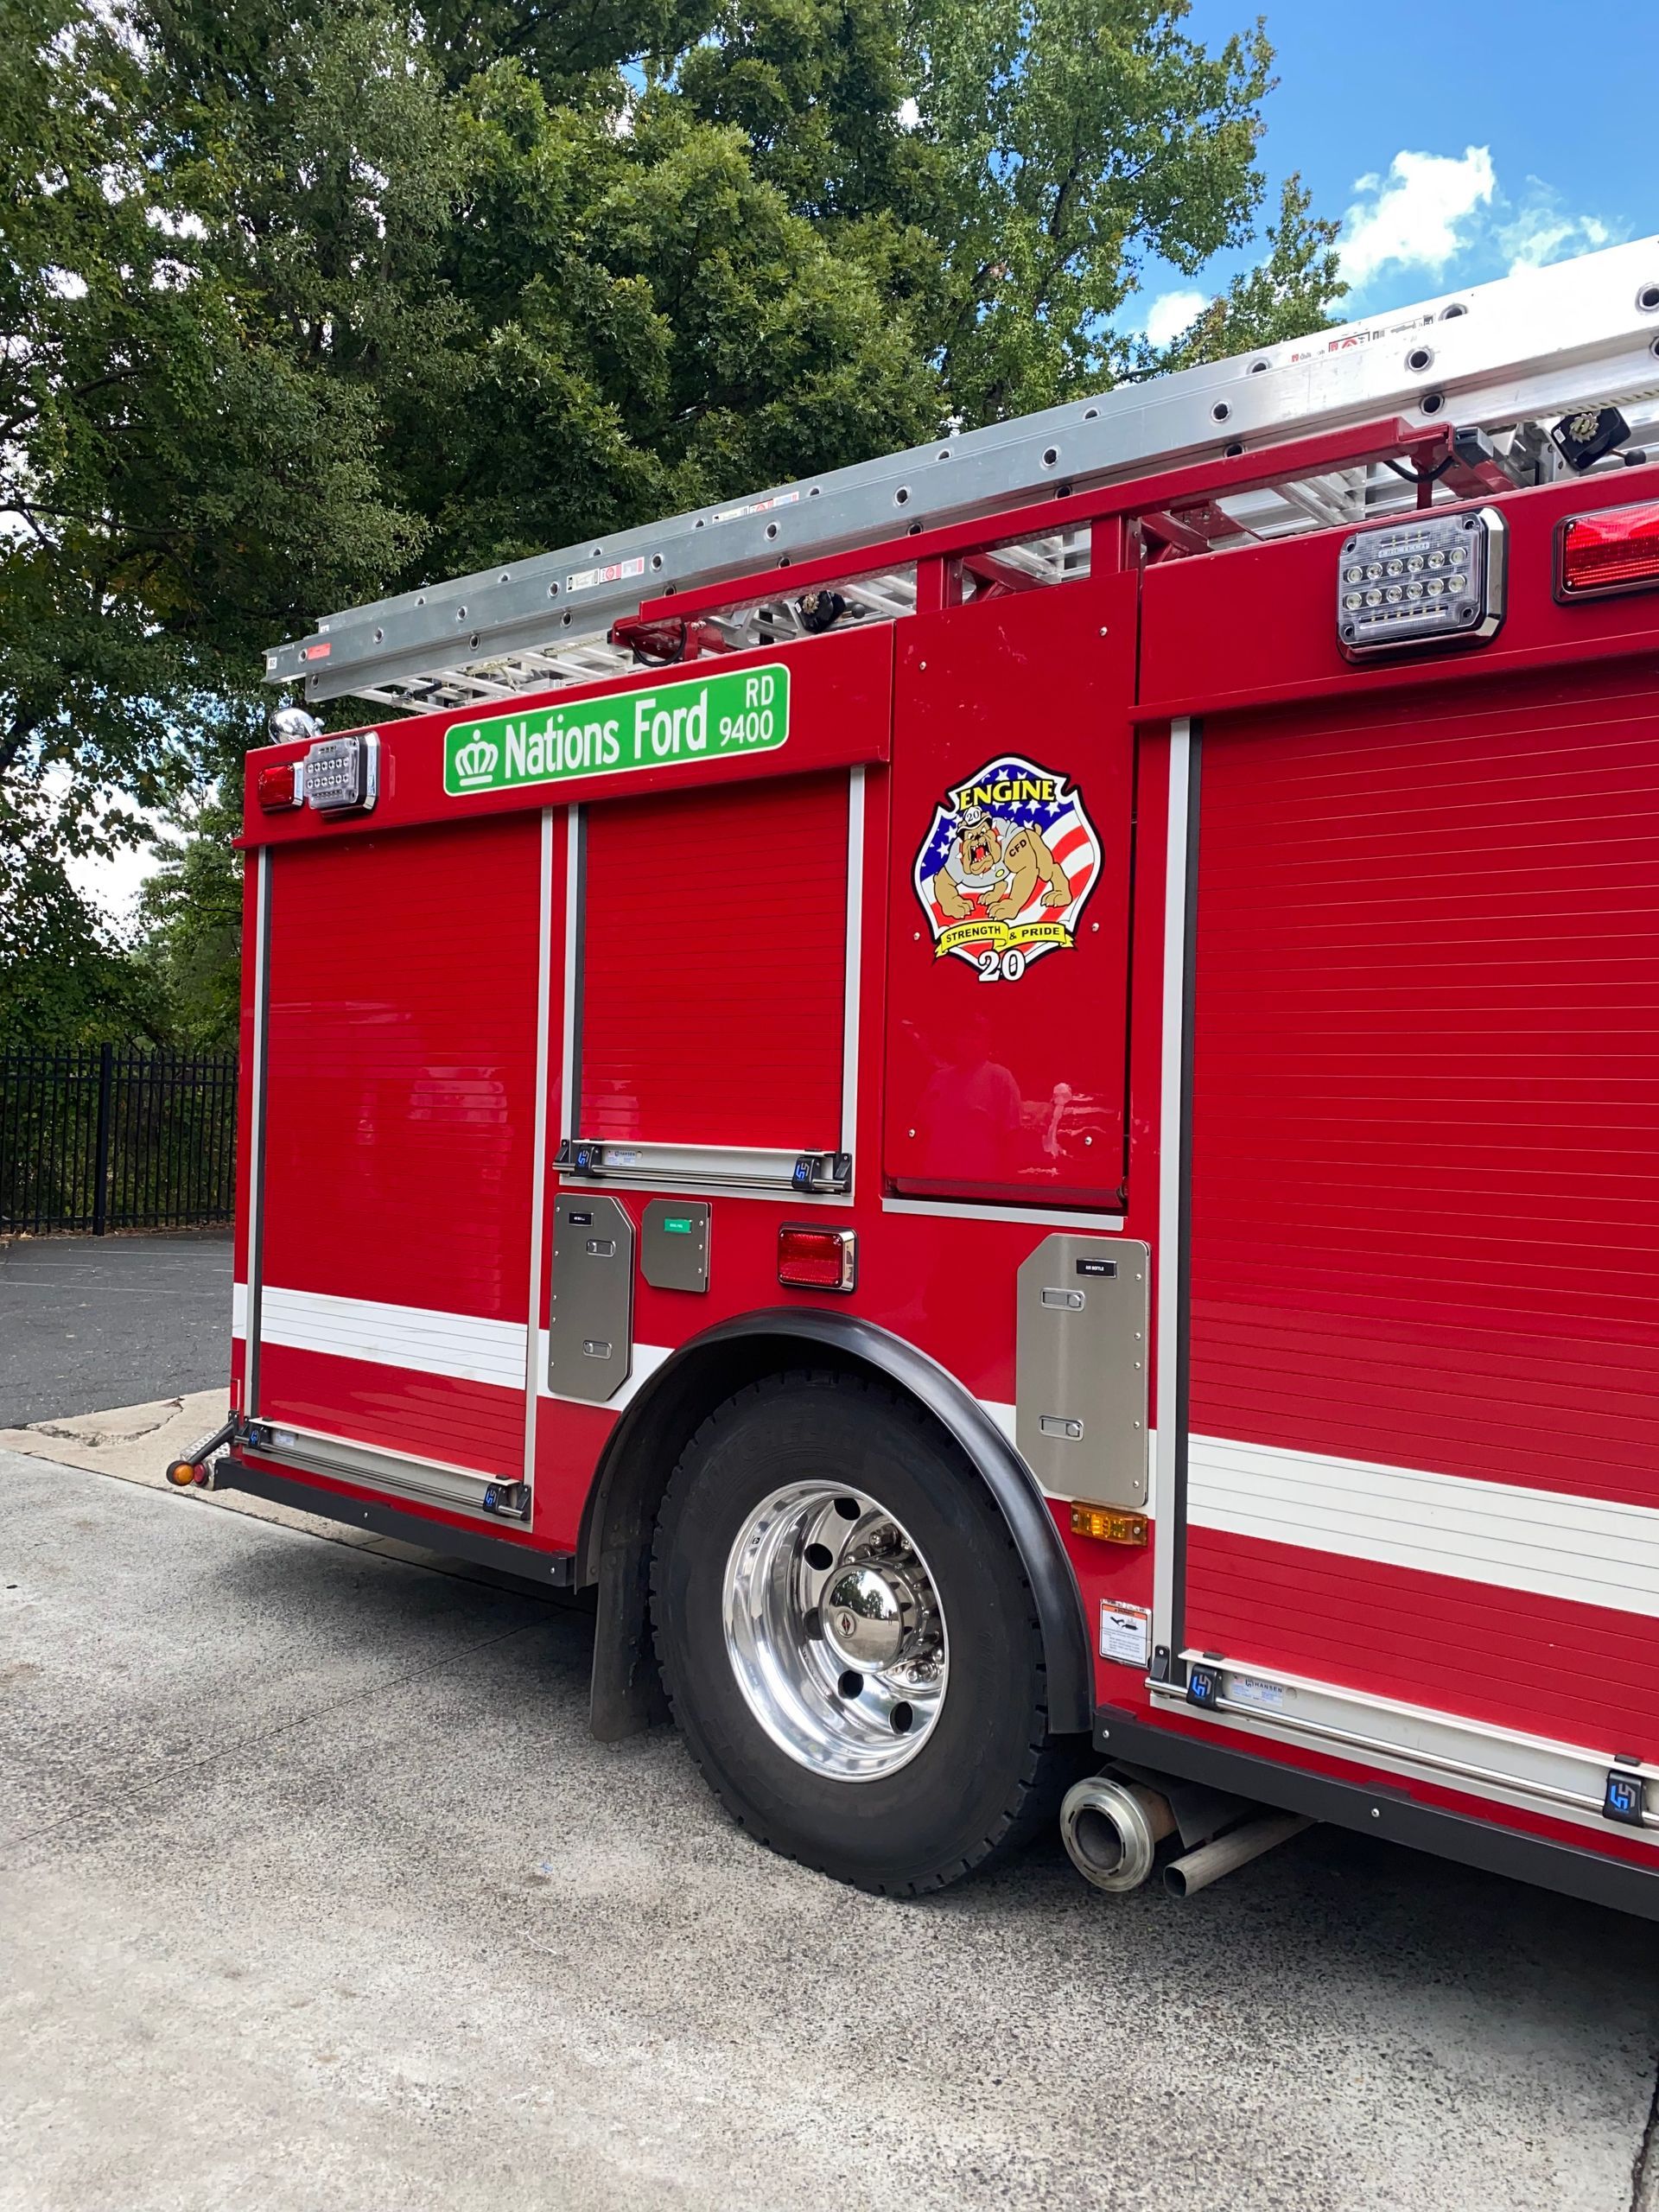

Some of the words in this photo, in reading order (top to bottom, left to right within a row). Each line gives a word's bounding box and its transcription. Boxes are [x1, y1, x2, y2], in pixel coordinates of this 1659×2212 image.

[746, 676, 774, 709] RD
[505, 714, 620, 779] Nations
[634, 688, 709, 760] Ford
[719, 709, 773, 747] 9400
[960, 779, 1055, 810] ENGINE
[967, 810, 980, 823] 20
[1008, 839, 1027, 857] CFD
[946, 925, 1001, 943] STRENGTH
[1009, 931, 1017, 940] &
[1021, 927, 1060, 938] PRIDE
[978, 949, 1026, 982] 20
